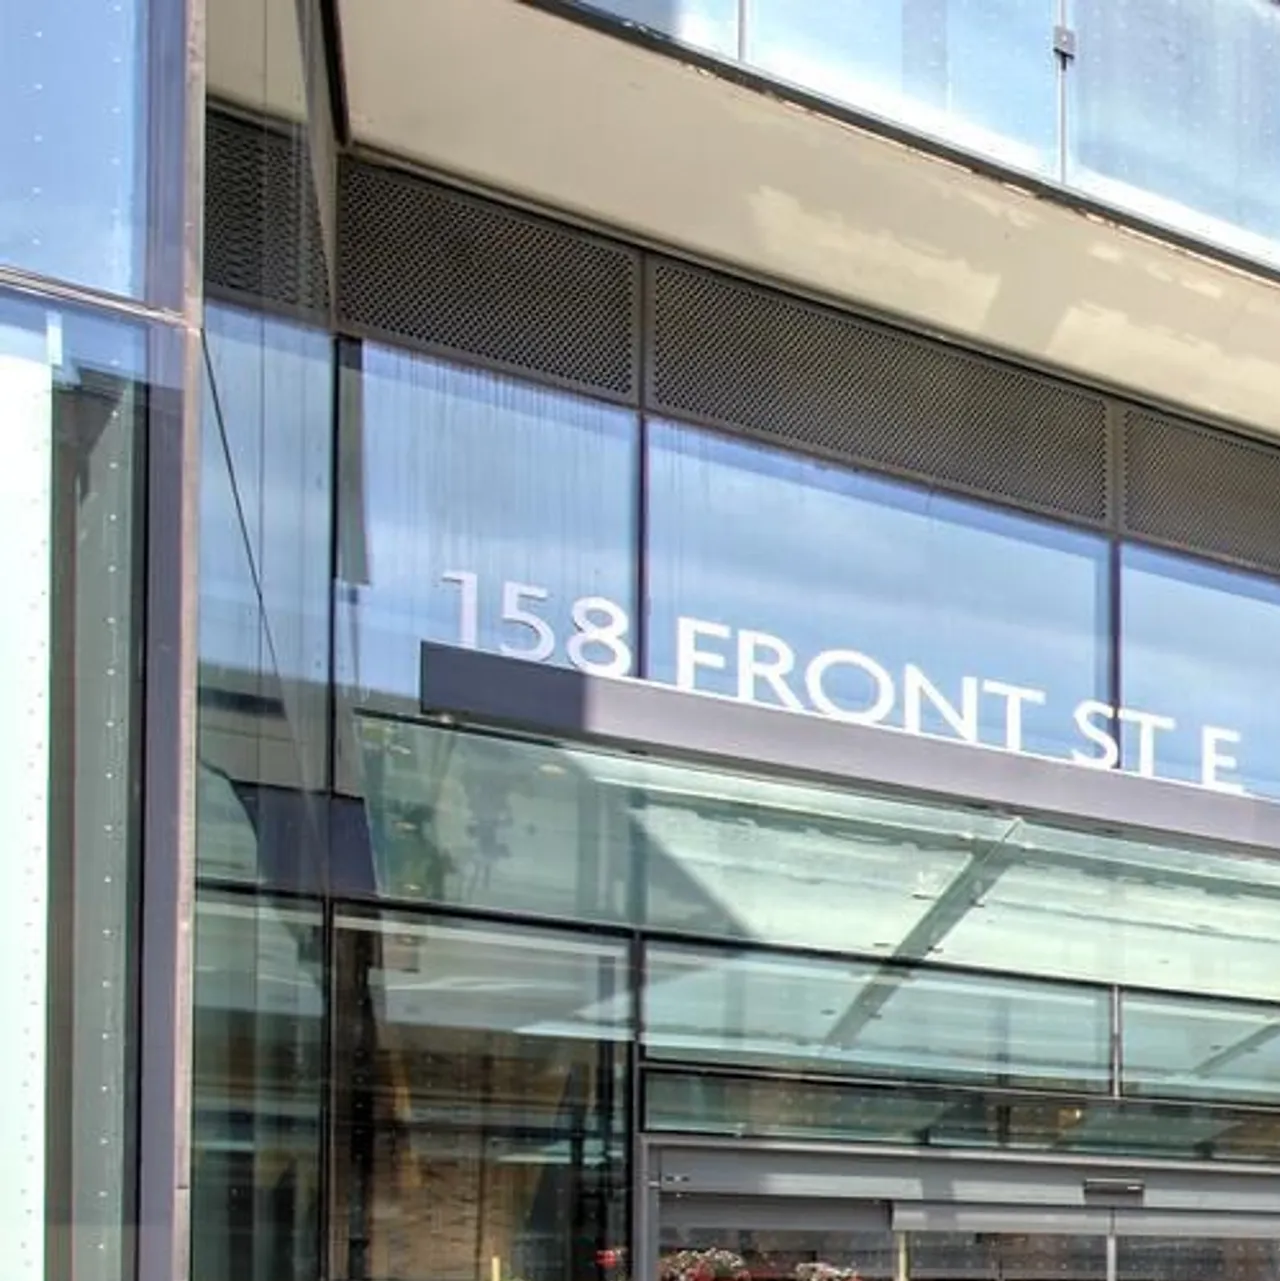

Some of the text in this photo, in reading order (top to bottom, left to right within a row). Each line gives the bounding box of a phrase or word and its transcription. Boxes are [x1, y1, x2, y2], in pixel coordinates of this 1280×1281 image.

[441, 570, 1245, 794] 158 FRONT ST E
